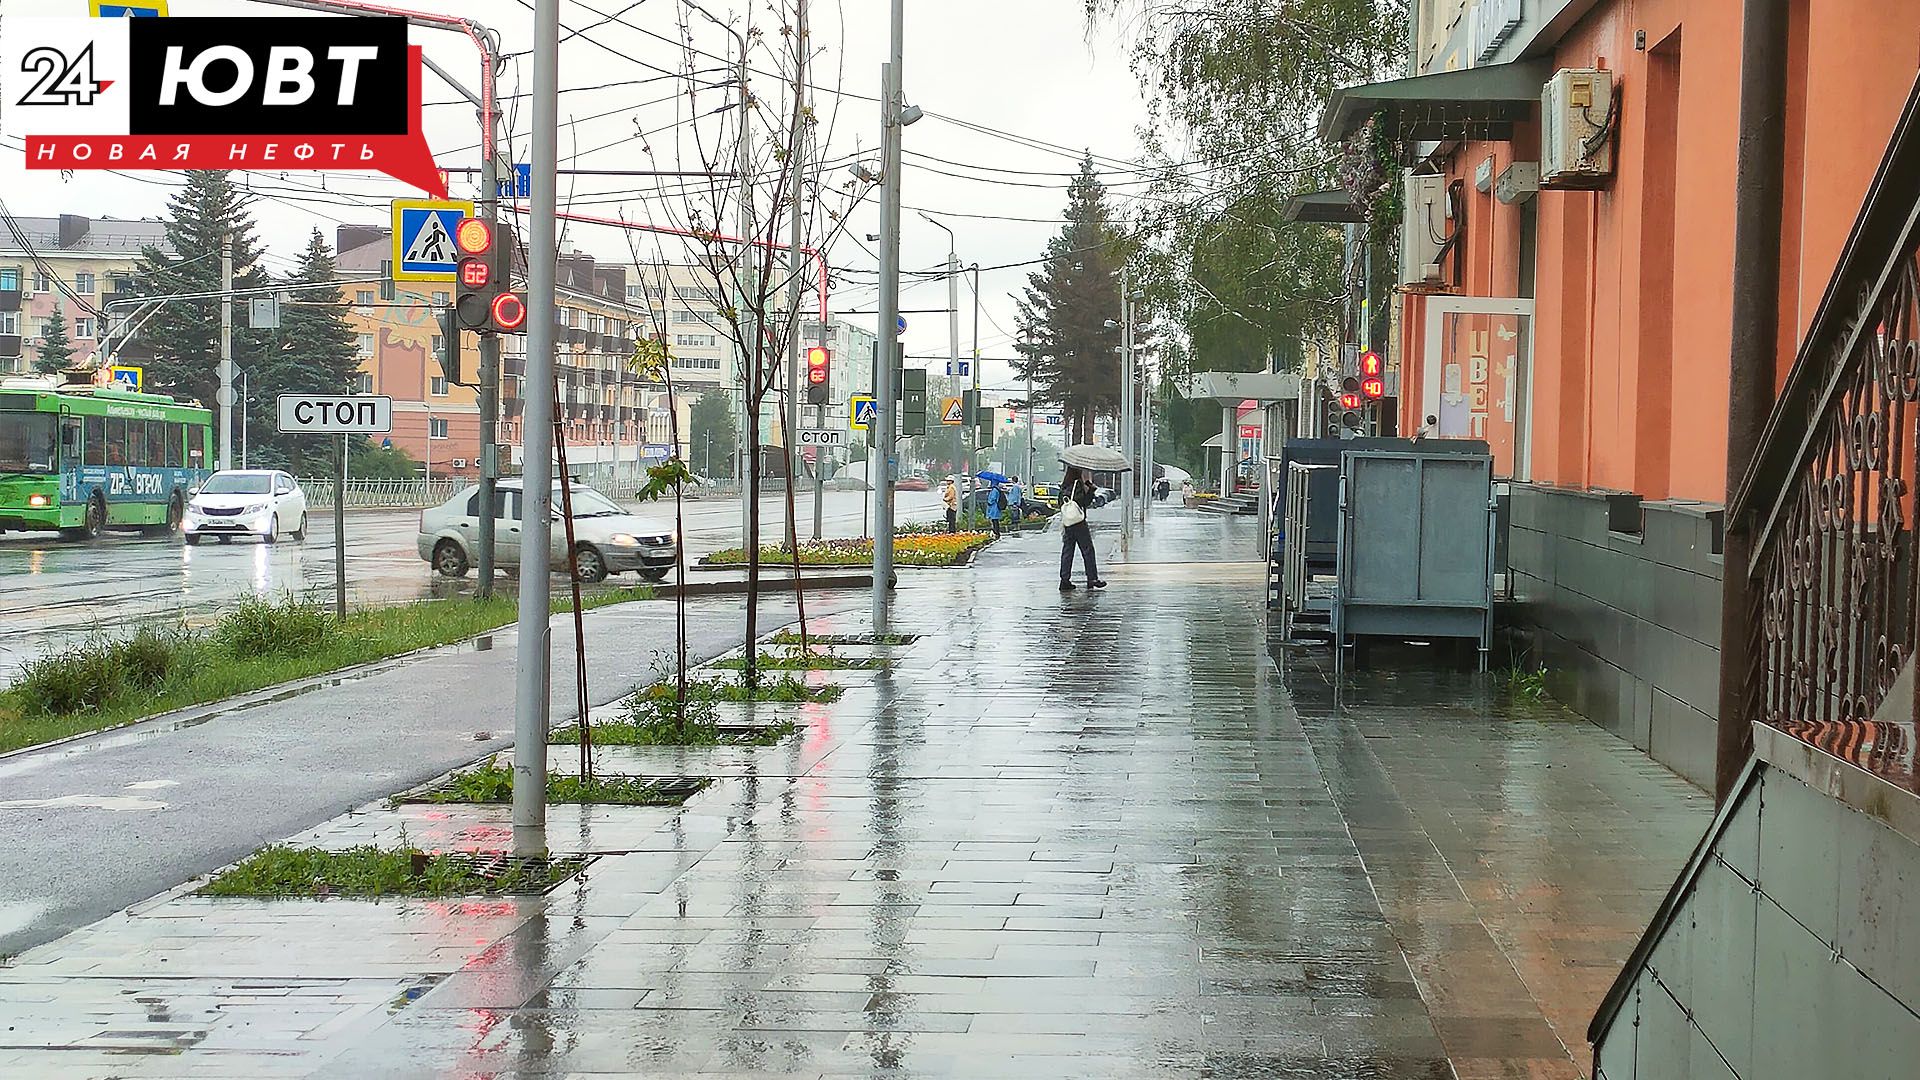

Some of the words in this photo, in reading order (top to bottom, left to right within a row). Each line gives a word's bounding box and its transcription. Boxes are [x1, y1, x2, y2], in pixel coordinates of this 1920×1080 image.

[464, 263, 488, 284] 62
[1364, 382, 1381, 395] 40
[1344, 397, 1358, 407] 41
[295, 401, 376, 425] СТОП
[801, 432, 839, 444] СТОП
